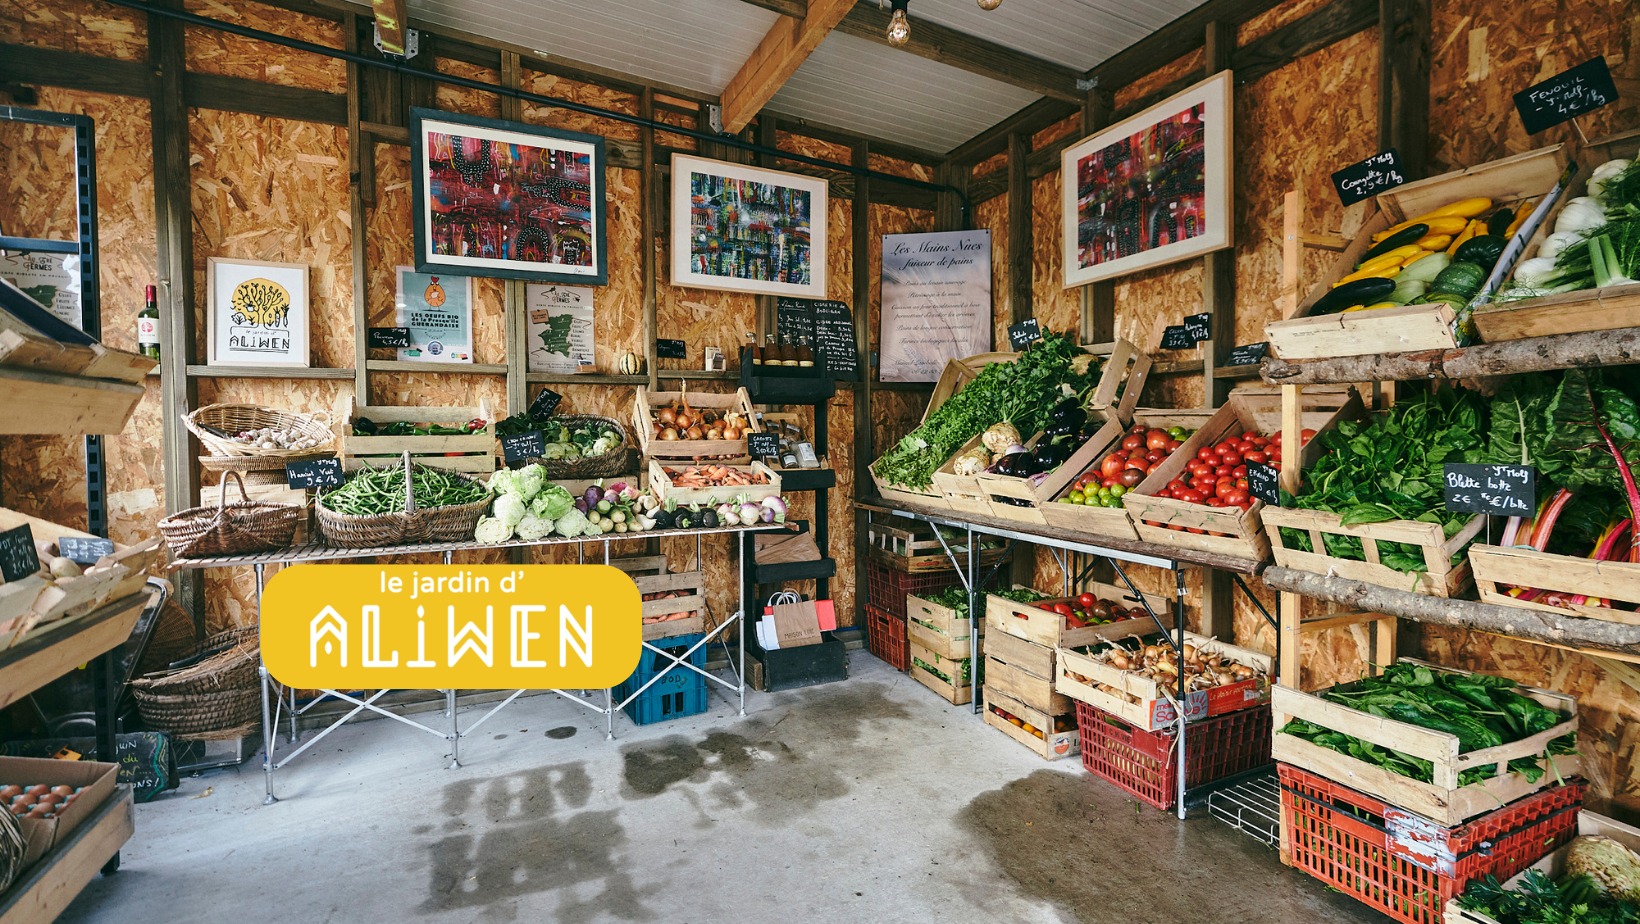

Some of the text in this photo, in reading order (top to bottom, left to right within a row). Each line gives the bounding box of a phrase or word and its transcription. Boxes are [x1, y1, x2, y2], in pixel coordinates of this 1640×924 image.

[1529, 76, 1585, 103] FENOUIL
[891, 238, 983, 256] Les Mains Nues
[898, 256, 974, 271] faiseur de pains
[1446, 472, 1512, 491] Blette botte
[122, 753, 139, 764] du
